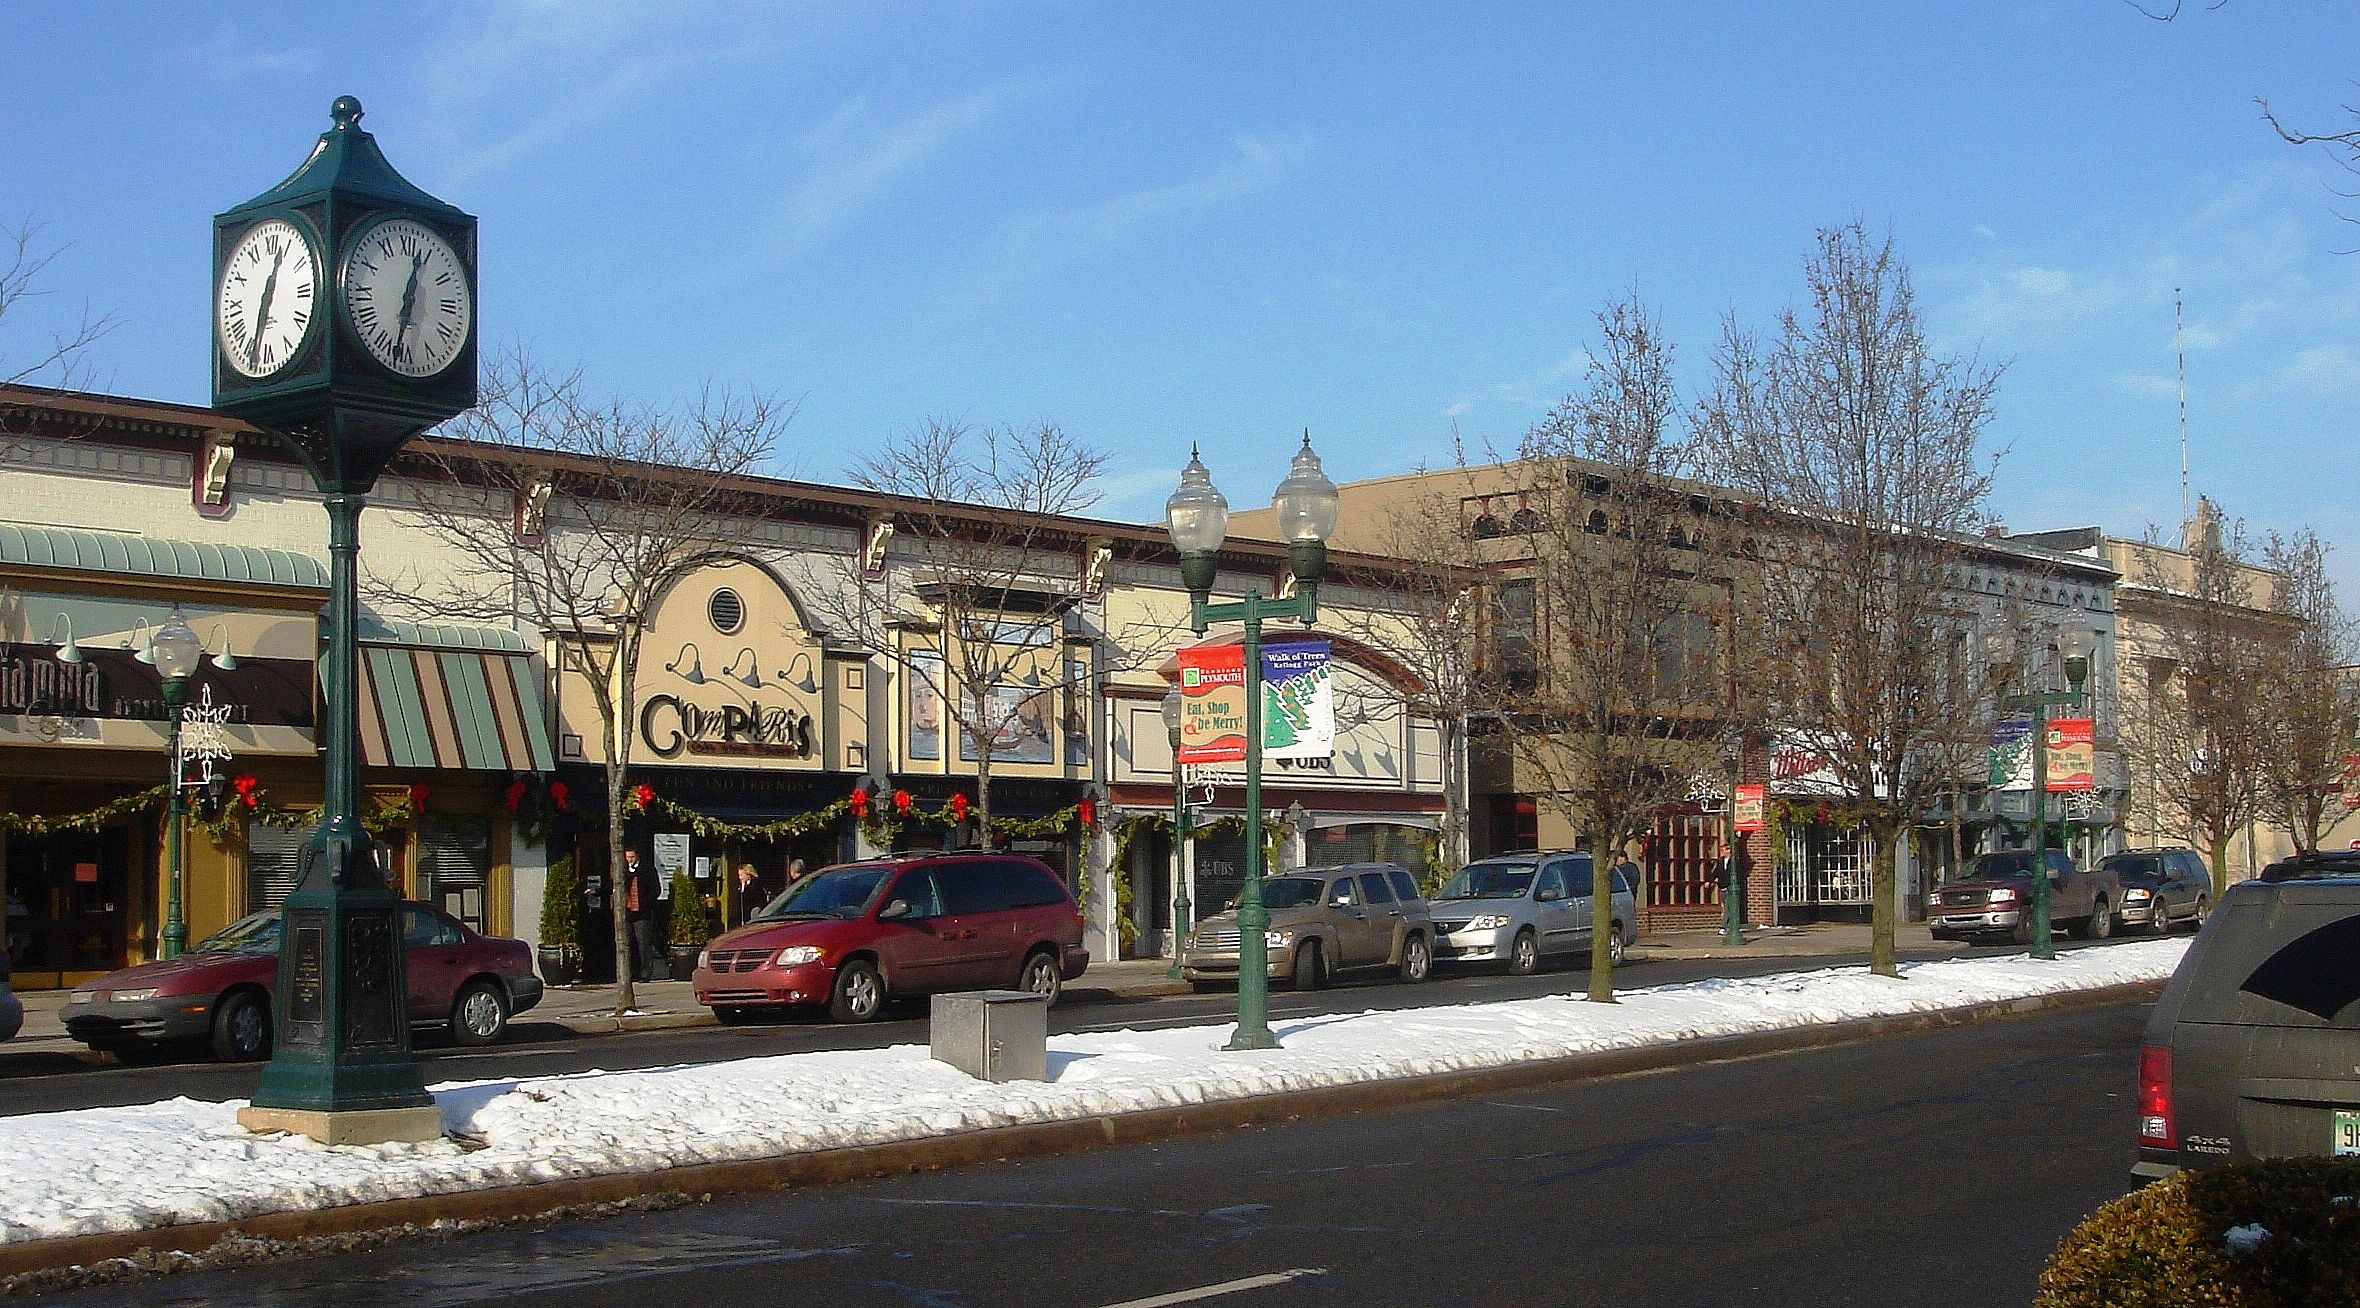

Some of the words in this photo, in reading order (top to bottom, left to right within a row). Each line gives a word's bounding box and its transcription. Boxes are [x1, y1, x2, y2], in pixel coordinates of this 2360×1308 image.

[1267, 653, 1290, 662] Walk
[1291, 652, 1301, 661] of
[1301, 652, 1326, 660] Trees
[1200, 673, 1242, 683] PLYMOUTH
[1187, 702, 1204, 716] Eat,
[1207, 701, 1229, 716] Shop
[1198, 717, 1210, 731] be
[1212, 715, 1243, 730] Merry!
[1213, 861, 1234, 876] UBS
